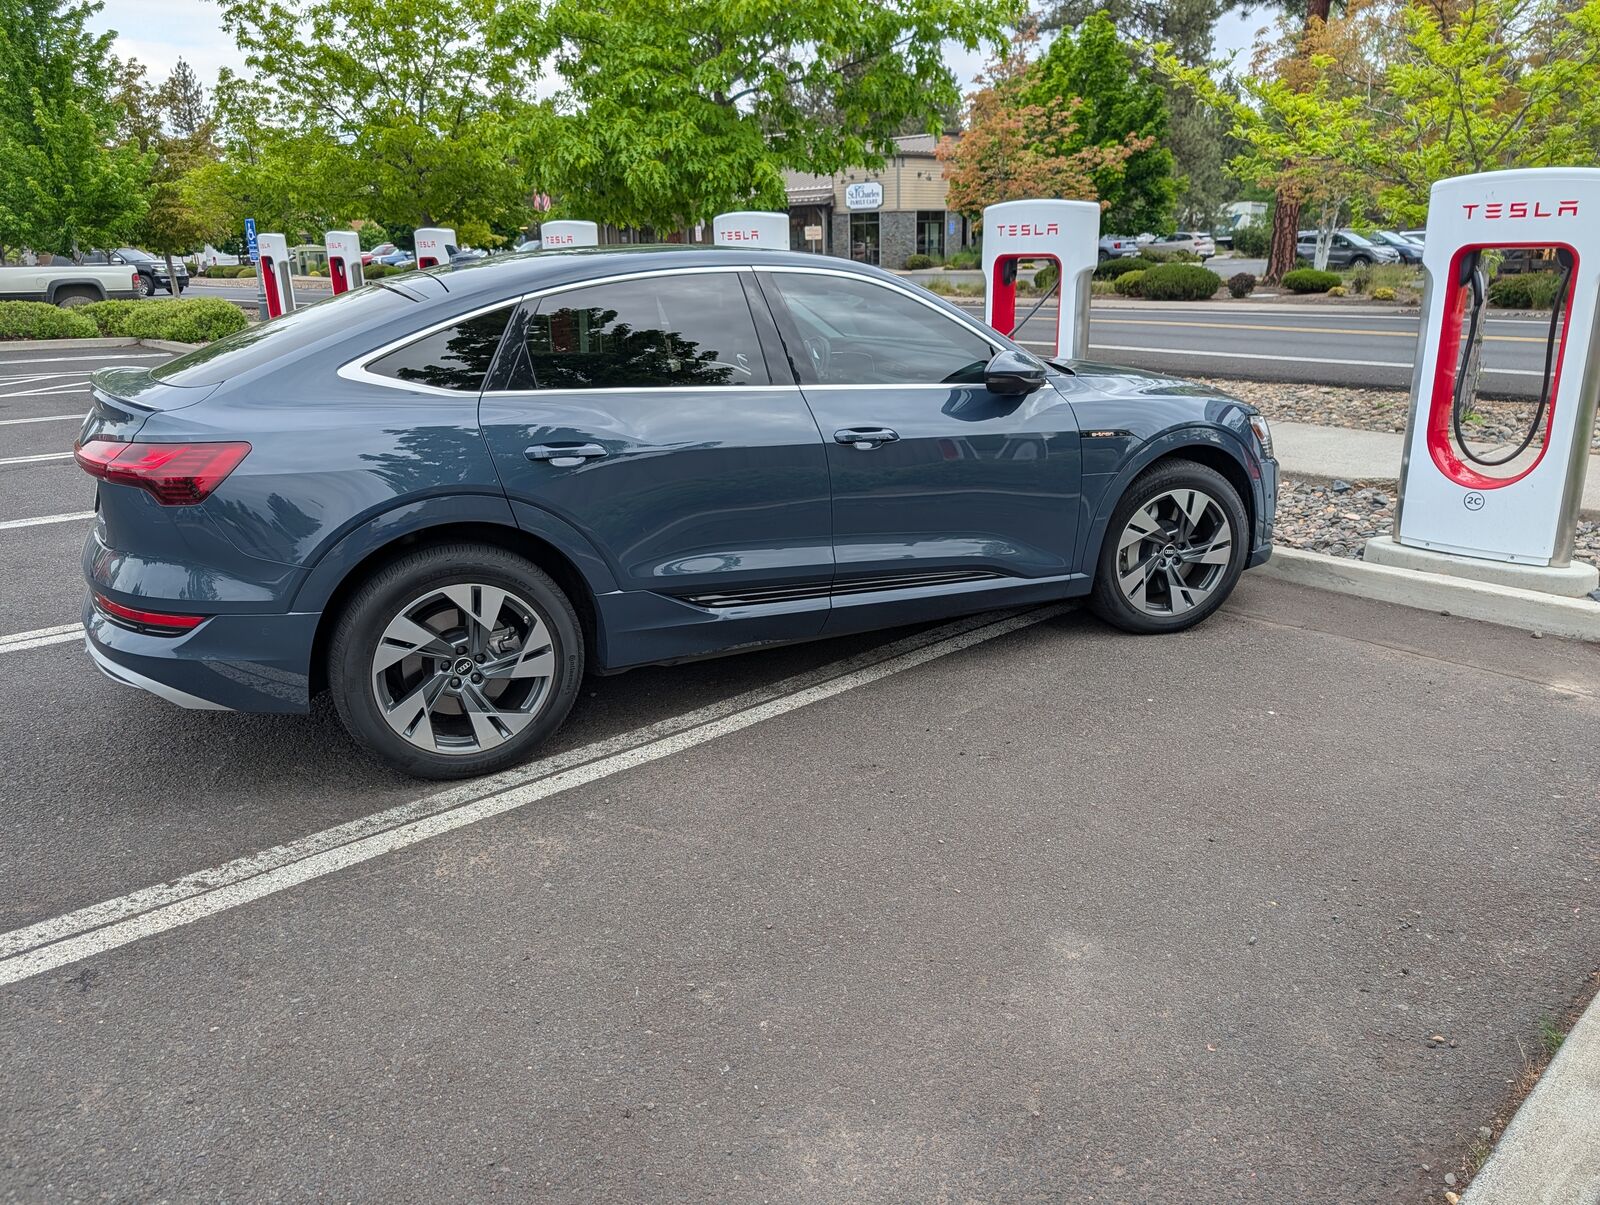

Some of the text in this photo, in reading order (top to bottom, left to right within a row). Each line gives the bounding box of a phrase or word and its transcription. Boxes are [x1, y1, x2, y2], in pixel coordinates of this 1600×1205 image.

[858, 189, 880, 199] Charles
[1462, 200, 1579, 220] TESLA
[997, 223, 1058, 237] TESLA
[545, 235, 574, 244] TESLA
[720, 230, 759, 241] TESLA
[416, 240, 436, 248] TESLA
[1466, 496, 1482, 506] 2C
